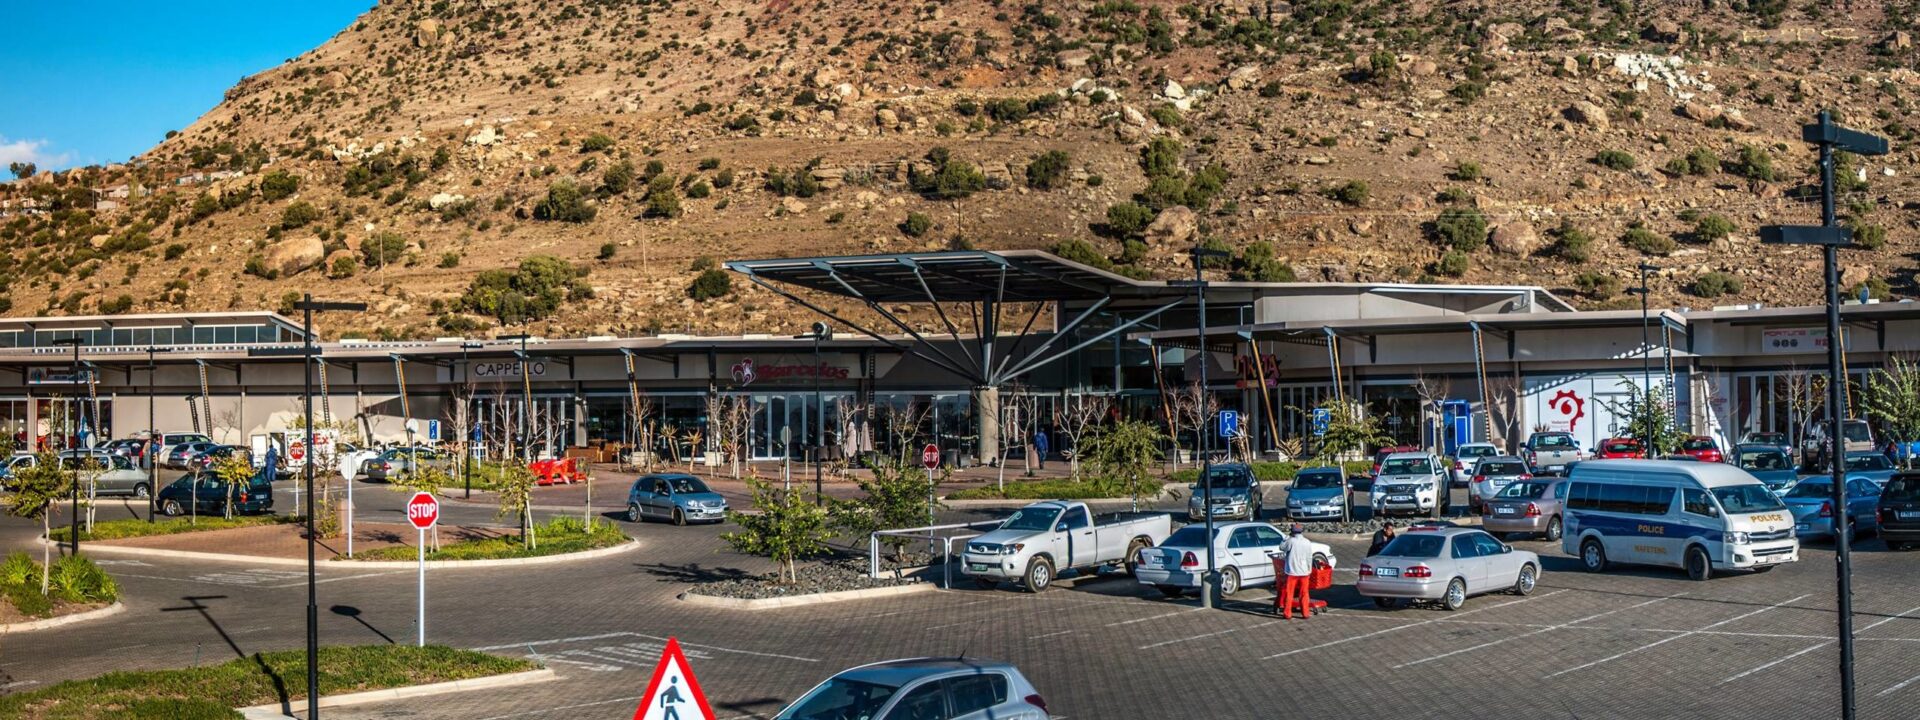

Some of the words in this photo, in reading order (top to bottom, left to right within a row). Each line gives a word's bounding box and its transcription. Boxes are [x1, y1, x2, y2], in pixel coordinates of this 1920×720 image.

[475, 363, 544, 376] CAPPELO
[1224, 412, 1233, 423] P
[410, 503, 436, 518] STOP
[1750, 514, 1783, 522] POLICE
[1638, 525, 1664, 534] POLICE
